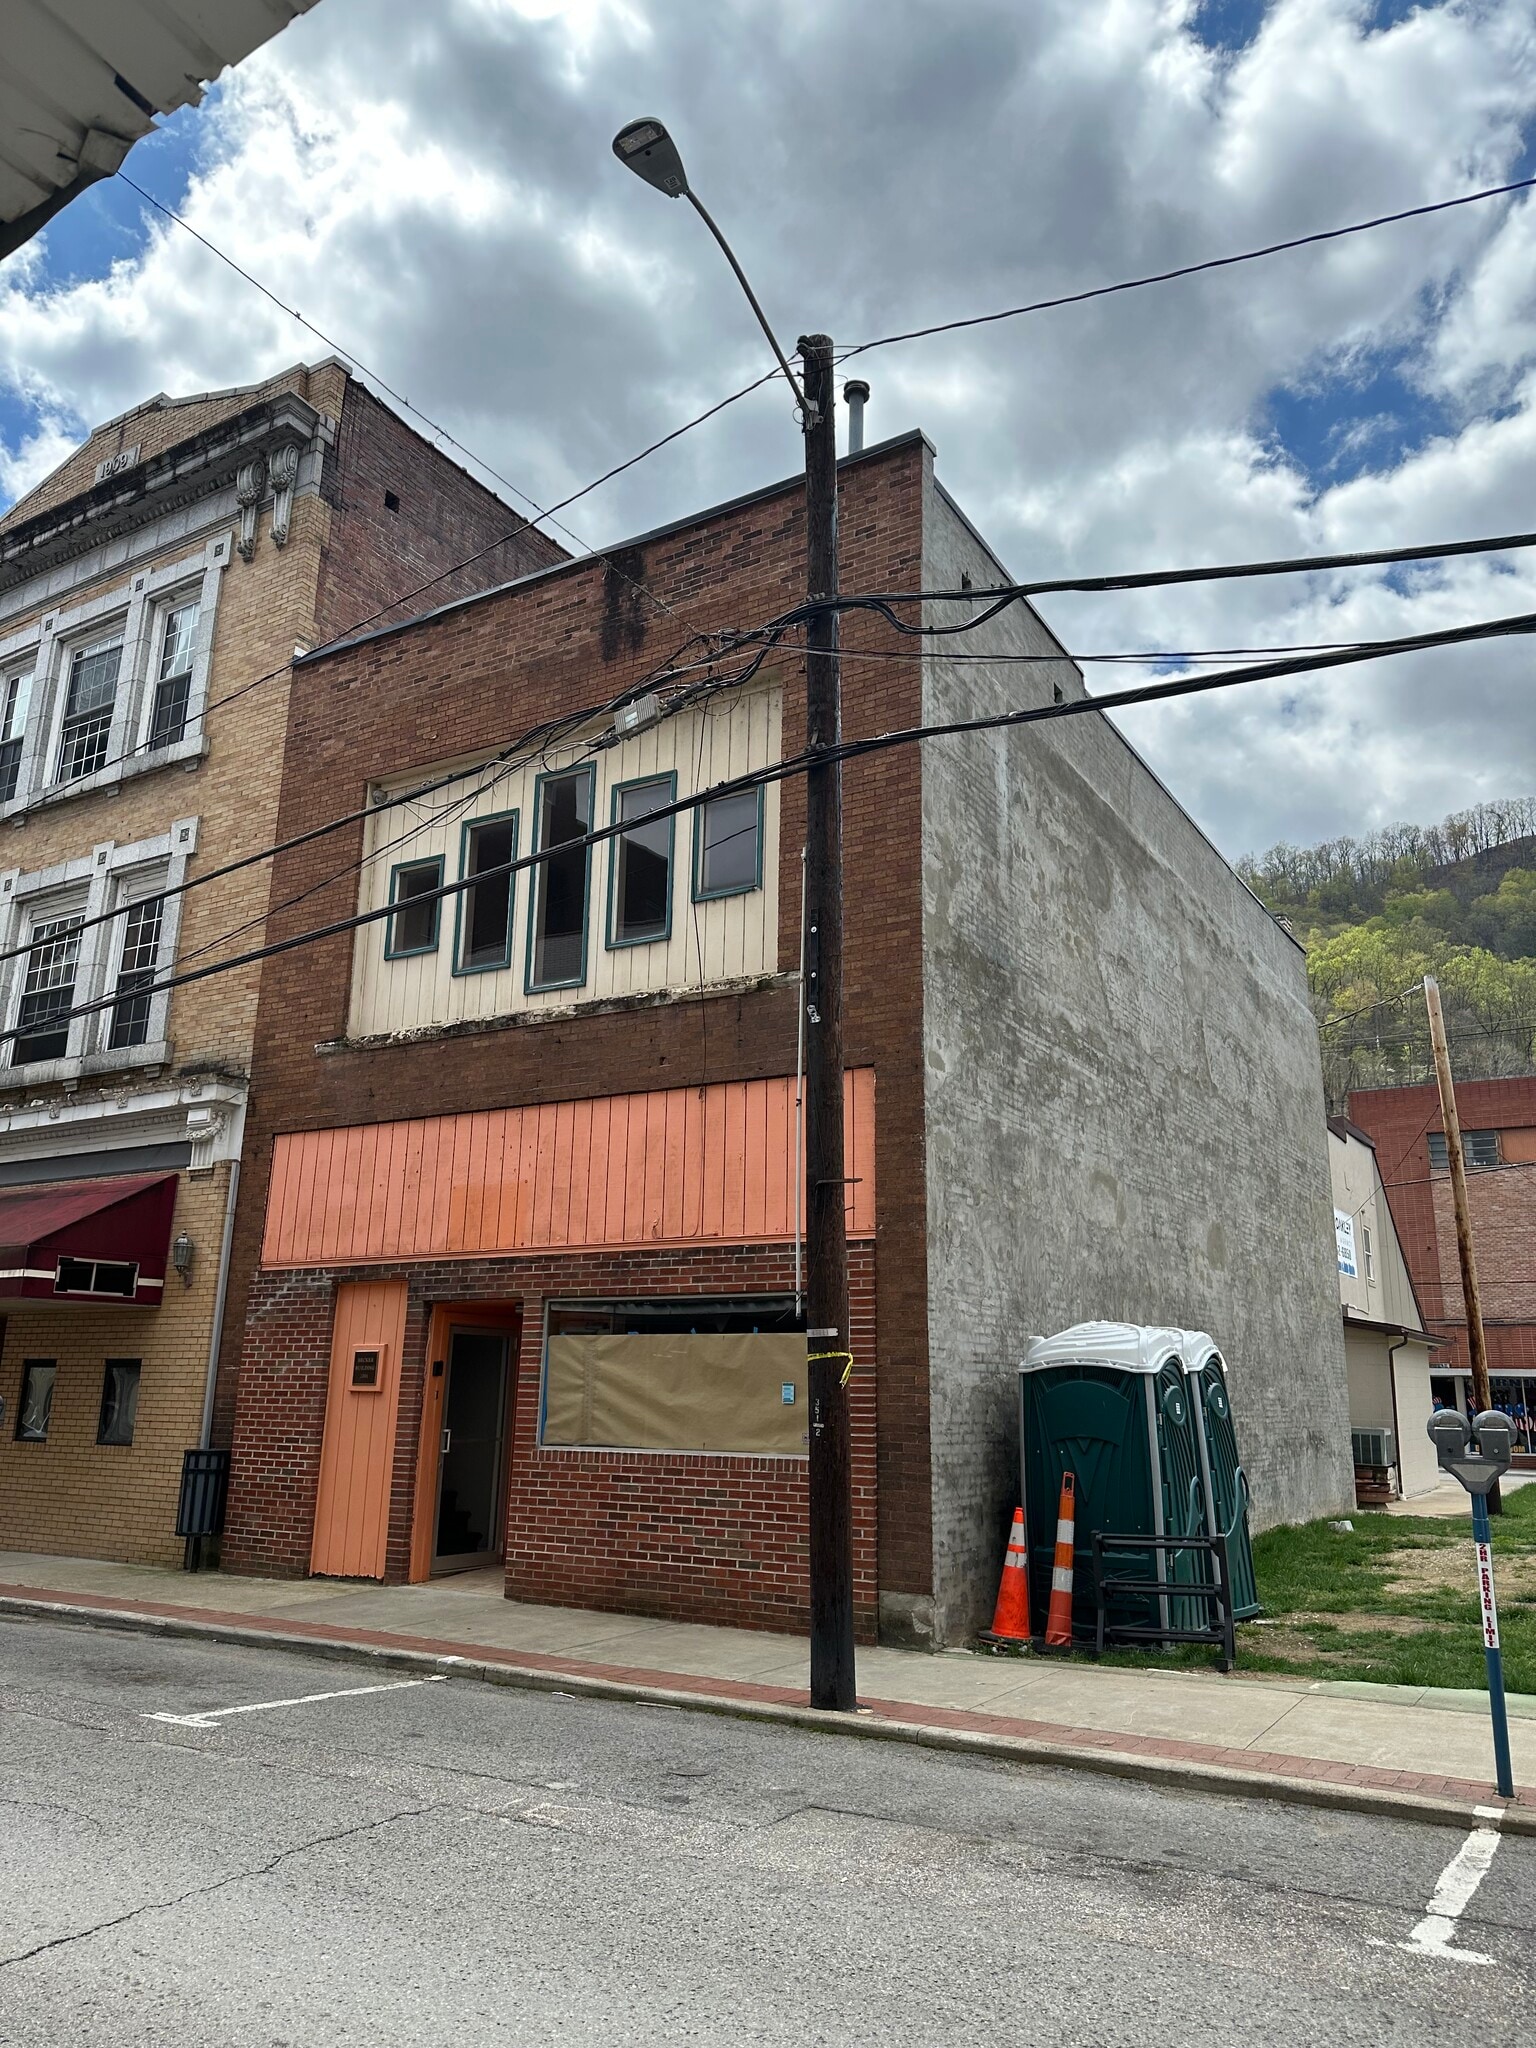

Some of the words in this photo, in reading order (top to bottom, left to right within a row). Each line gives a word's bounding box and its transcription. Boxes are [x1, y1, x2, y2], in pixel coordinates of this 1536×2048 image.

[100, 453, 128, 478] 1909
[1478, 1543, 1488, 1562] 2HR
[1481, 1567, 1492, 1611] PARKING
[1485, 1616, 1496, 1648] LIMIT
